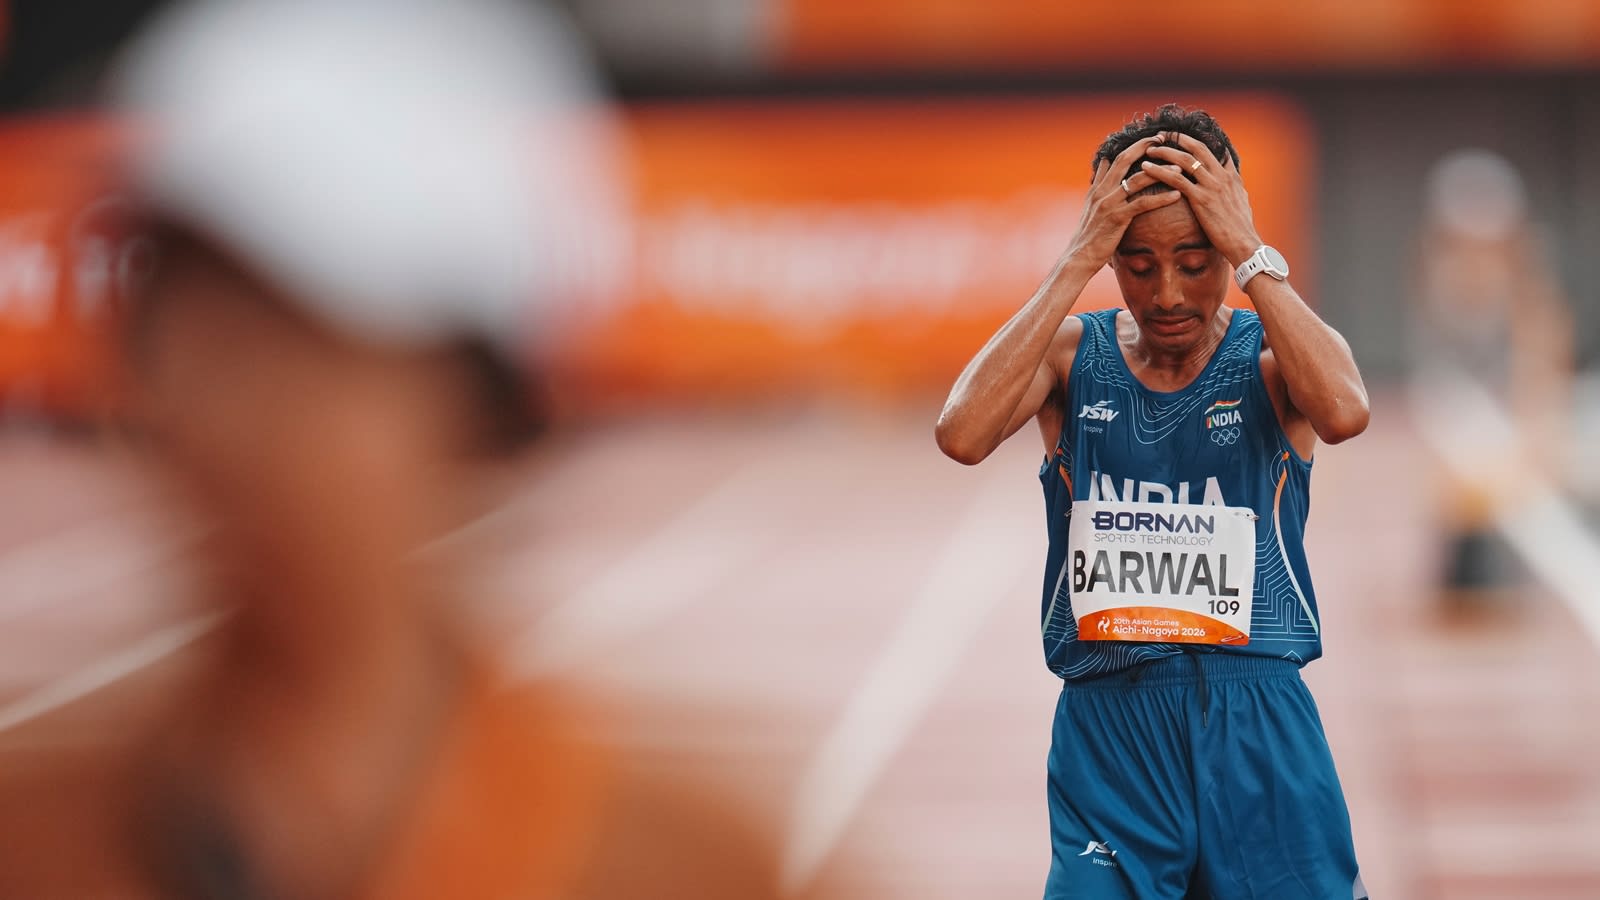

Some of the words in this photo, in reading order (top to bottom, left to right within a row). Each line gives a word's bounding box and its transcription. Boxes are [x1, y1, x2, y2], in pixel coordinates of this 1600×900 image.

[1077, 404, 1120, 423] JSW
[1206, 409, 1243, 429] INDIA
[1091, 511, 1214, 534] BORNAN
[1094, 533, 1136, 544] SPORTS
[1140, 534, 1214, 546] TECHNOLOGY
[1073, 550, 1239, 597] BARWAL
[1207, 600, 1240, 616] 109
[1113, 617, 1130, 625] 20th
[1132, 618, 1152, 626] Asian
[1153, 619, 1180, 627] Games
[1112, 625, 1179, 637] Aichi-Nagoya
[1181, 627, 1206, 637] 2026
